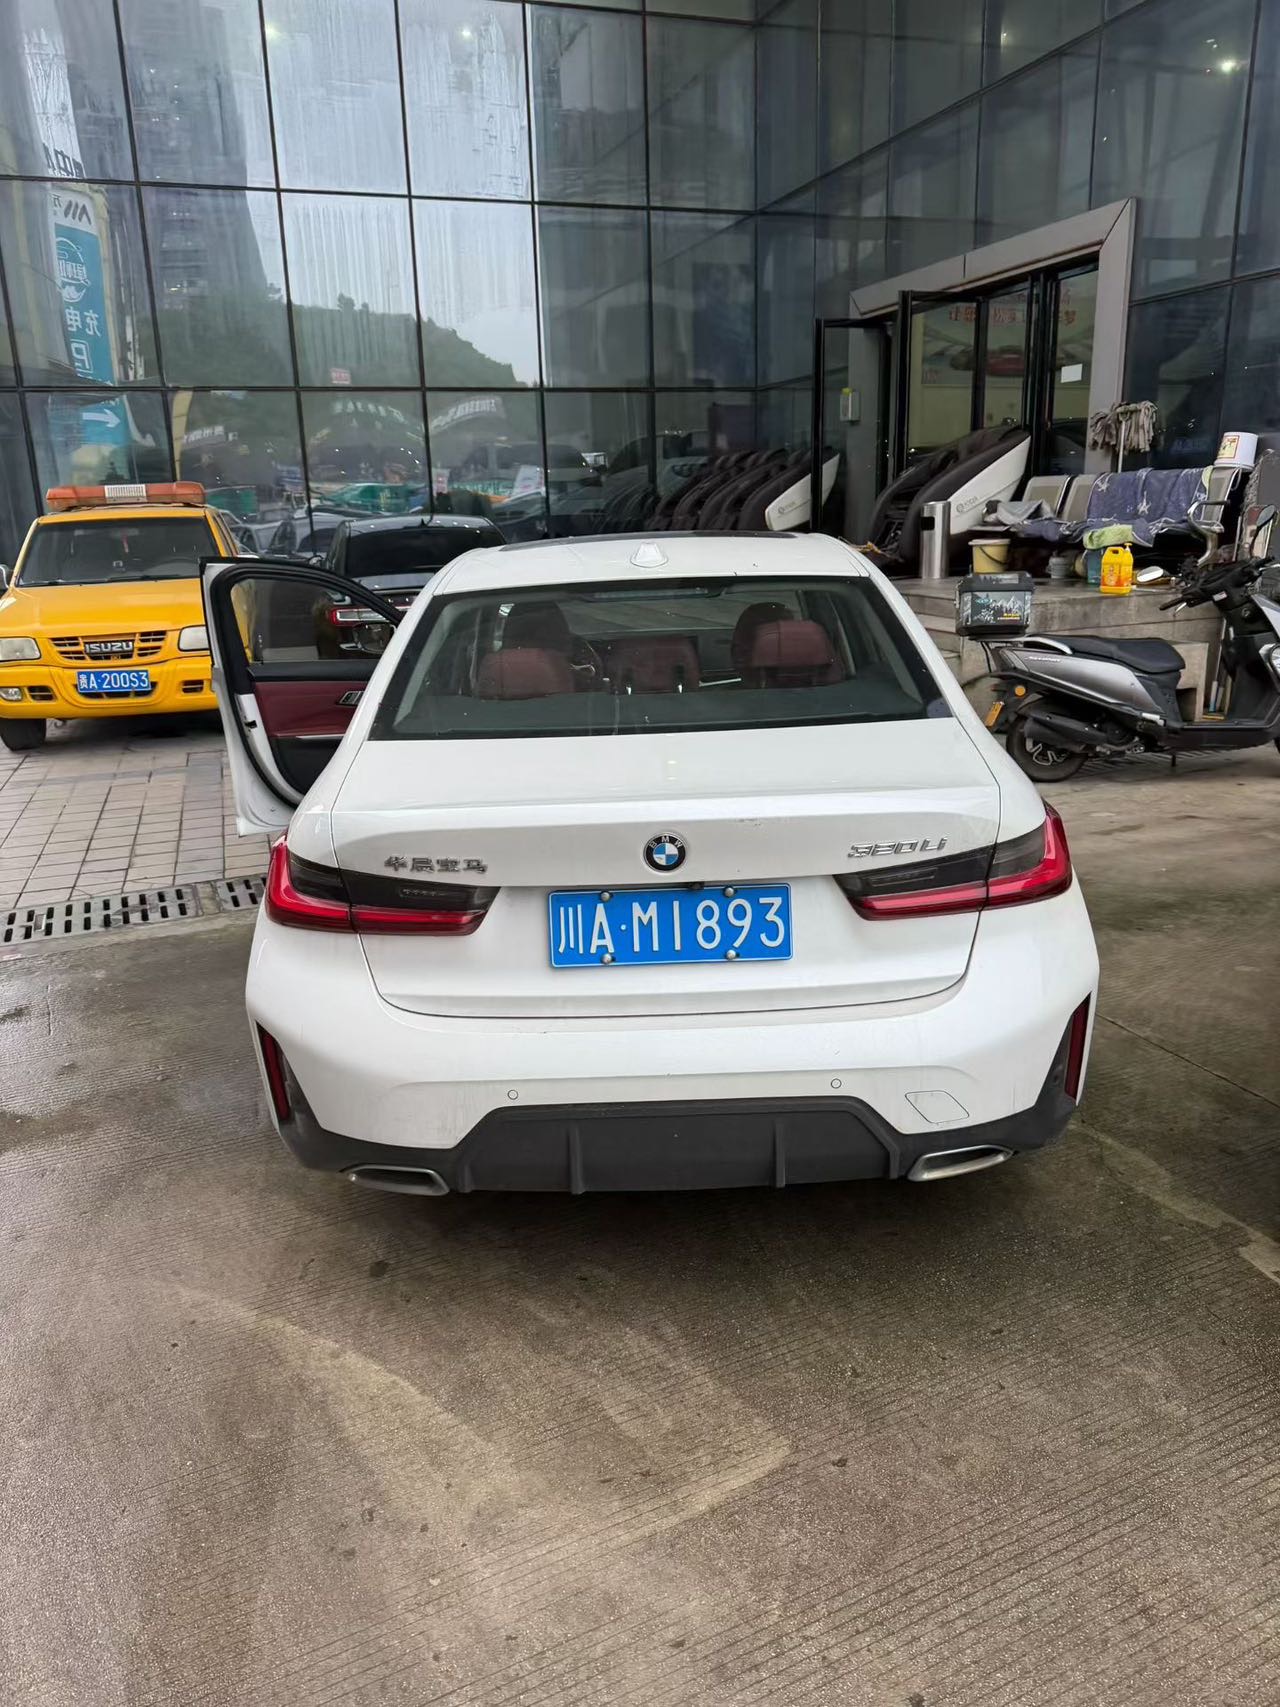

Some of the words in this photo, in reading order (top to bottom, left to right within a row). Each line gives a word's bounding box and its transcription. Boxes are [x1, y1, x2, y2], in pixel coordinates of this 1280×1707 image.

[84, 641, 134, 653] ISUZU
[649, 836, 683, 849] BMW
[847, 837, 948, 858] 320Li
[384, 855, 488, 874] 华晨宝马
[557, 896, 785, 955] 川A·M1893
